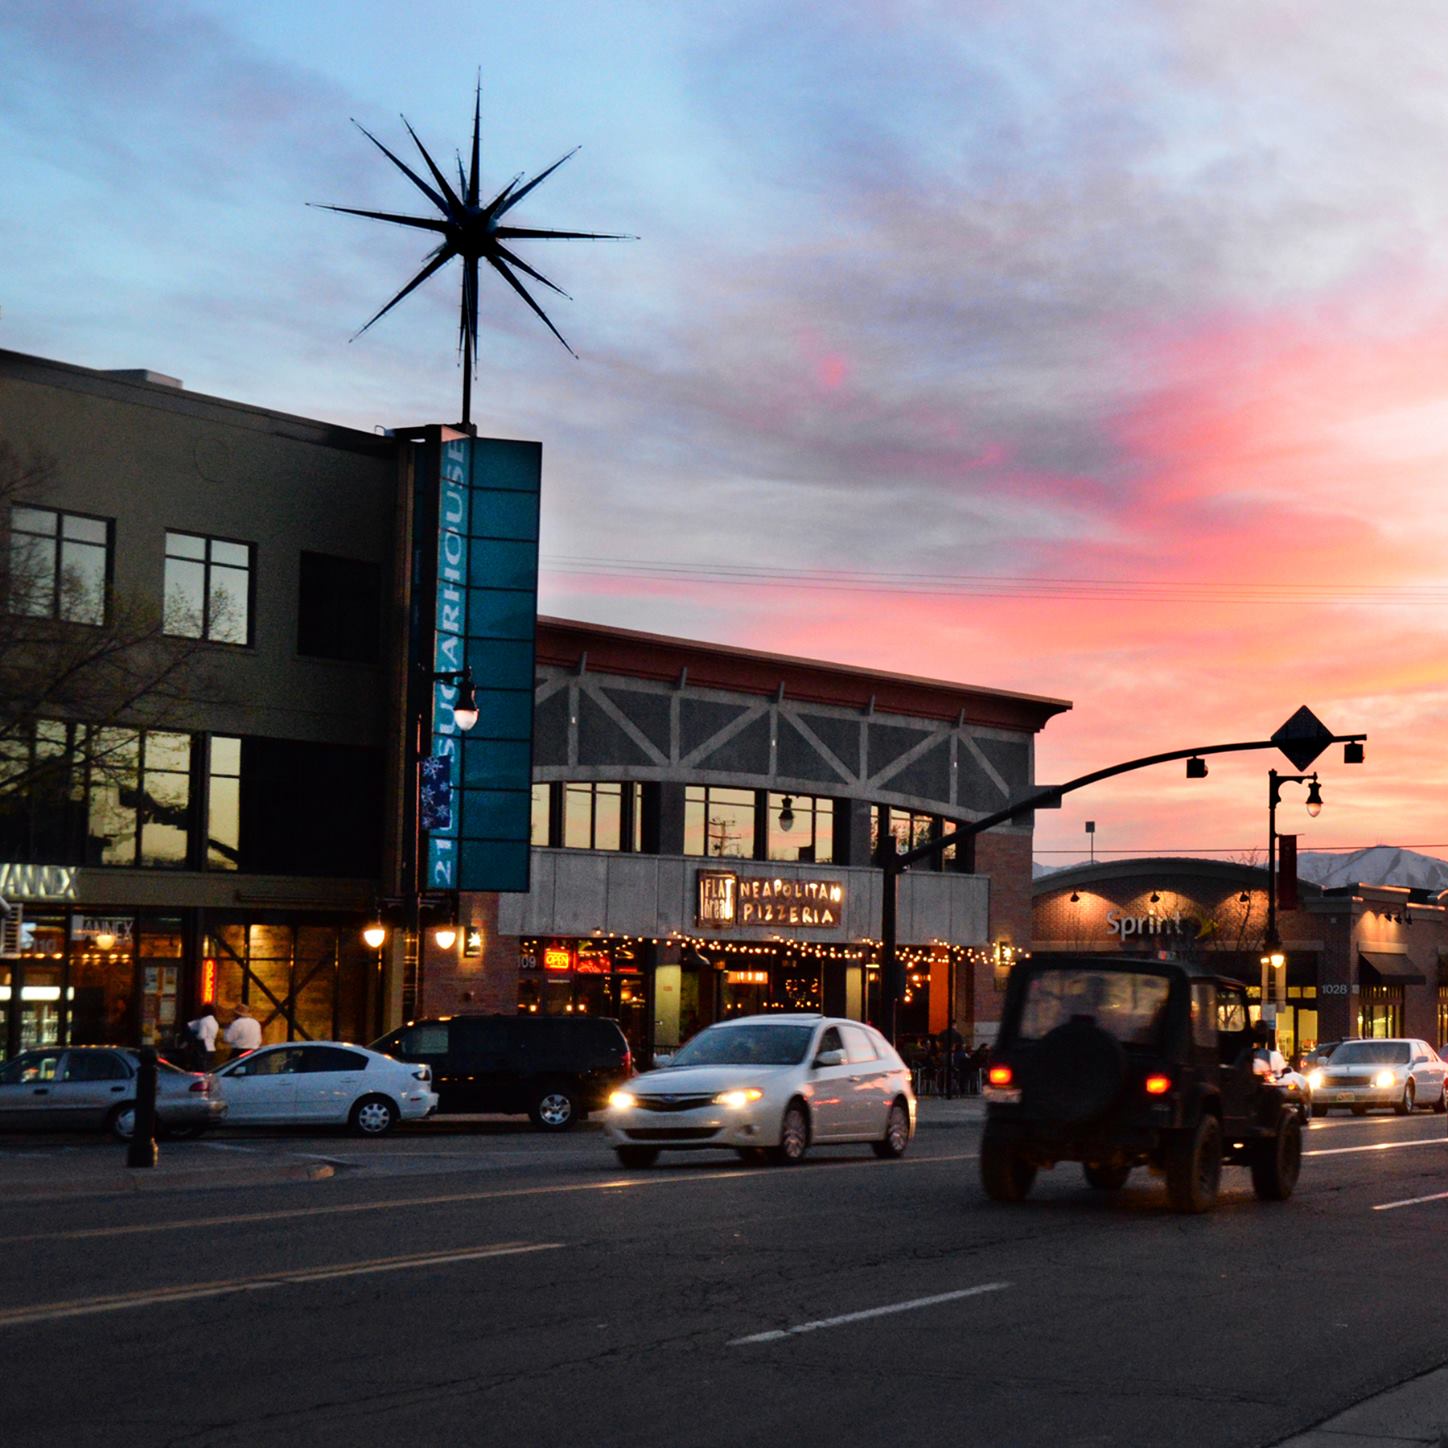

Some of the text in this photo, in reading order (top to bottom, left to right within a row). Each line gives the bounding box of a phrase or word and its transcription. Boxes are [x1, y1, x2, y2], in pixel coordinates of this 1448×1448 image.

[704, 879, 734, 898] FLAT
[740, 880, 841, 902] NEAPOLITAN
[743, 904, 833, 923] PIZZERIA
[1106, 911, 1183, 941] Sprint
[1321, 984, 1347, 994] 1028
